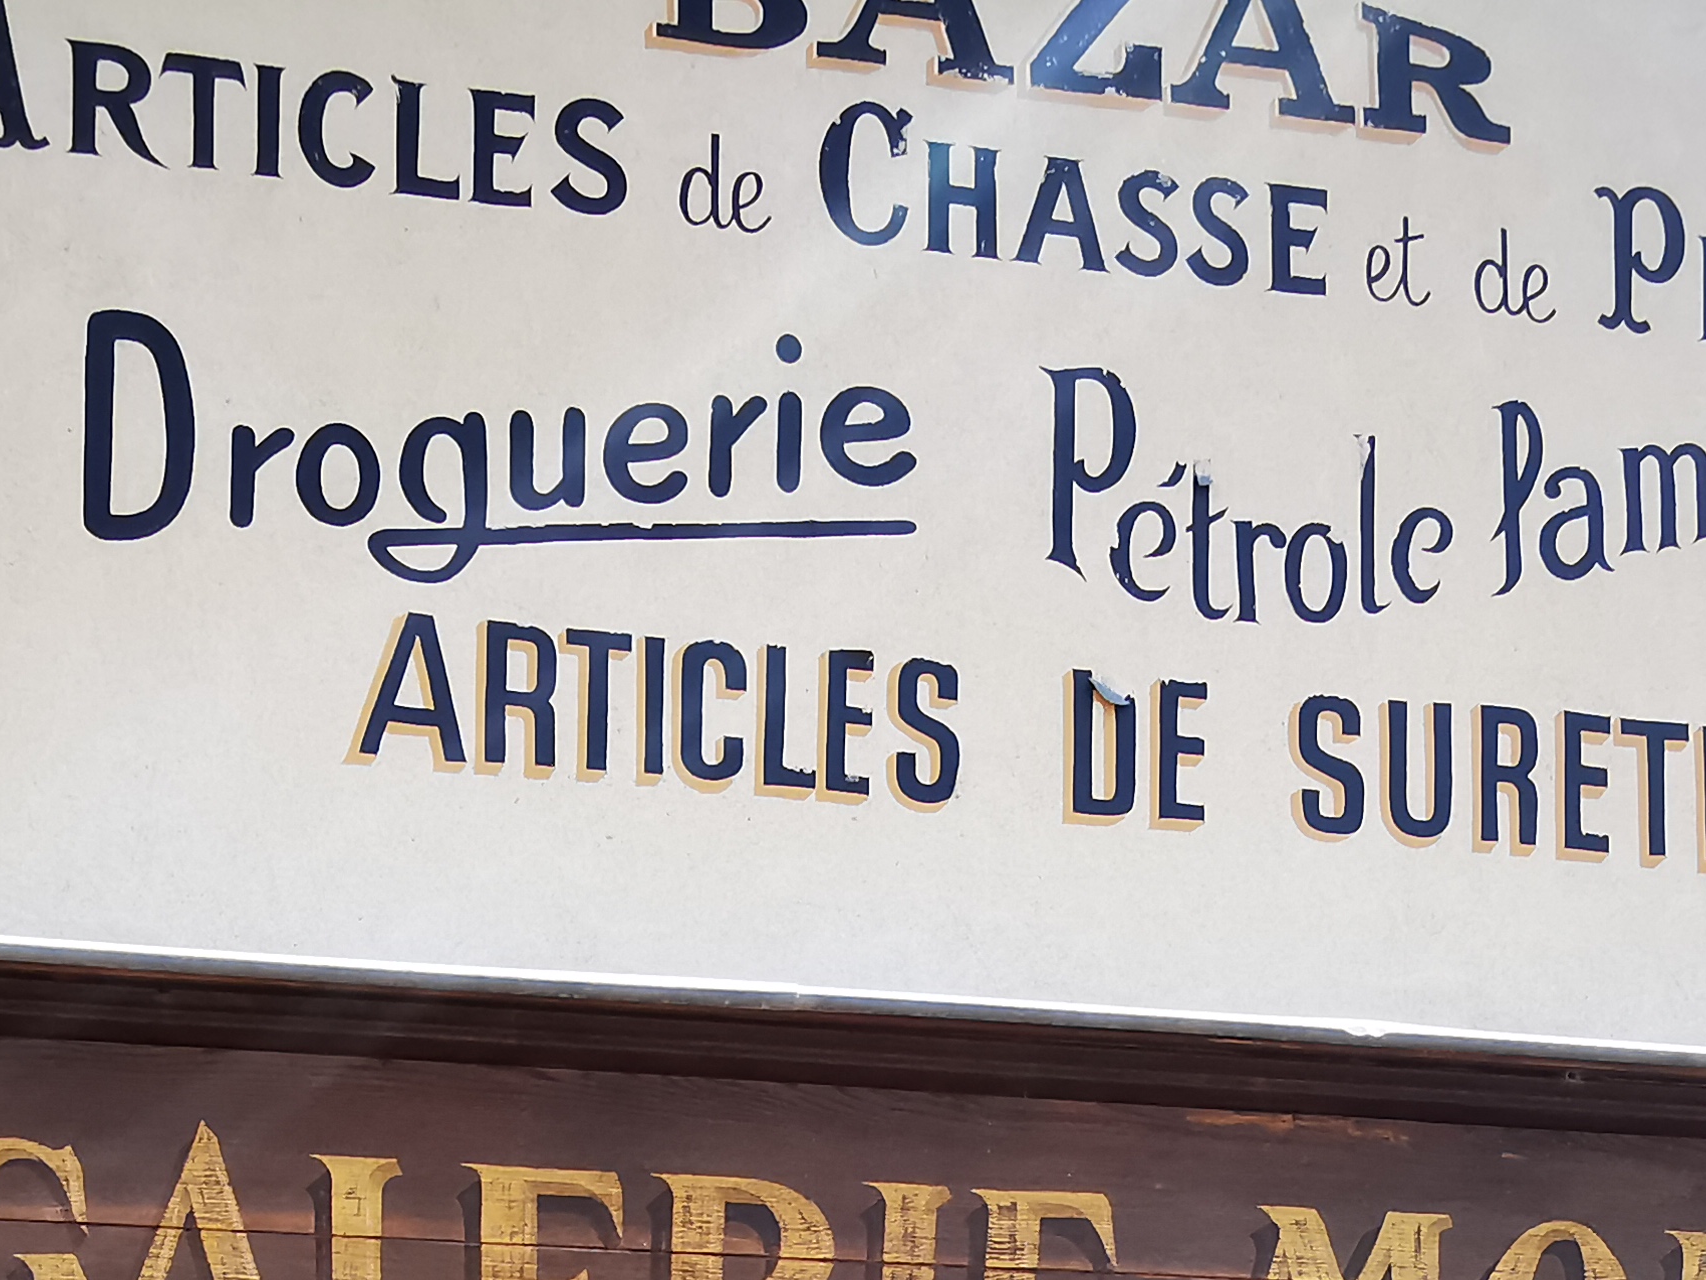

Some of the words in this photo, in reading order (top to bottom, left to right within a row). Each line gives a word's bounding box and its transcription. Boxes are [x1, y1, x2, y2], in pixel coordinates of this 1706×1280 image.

[679, 133, 773, 233] de
[819, 101, 1328, 298] CHASSE
[1364, 217, 1432, 307] et
[1474, 228, 1557, 324] de
[82, 309, 917, 584] Droguerie
[1038, 365, 1454, 624] Pétrole
[343, 611, 961, 813] ARTICLES
[1062, 667, 1208, 832] DE
